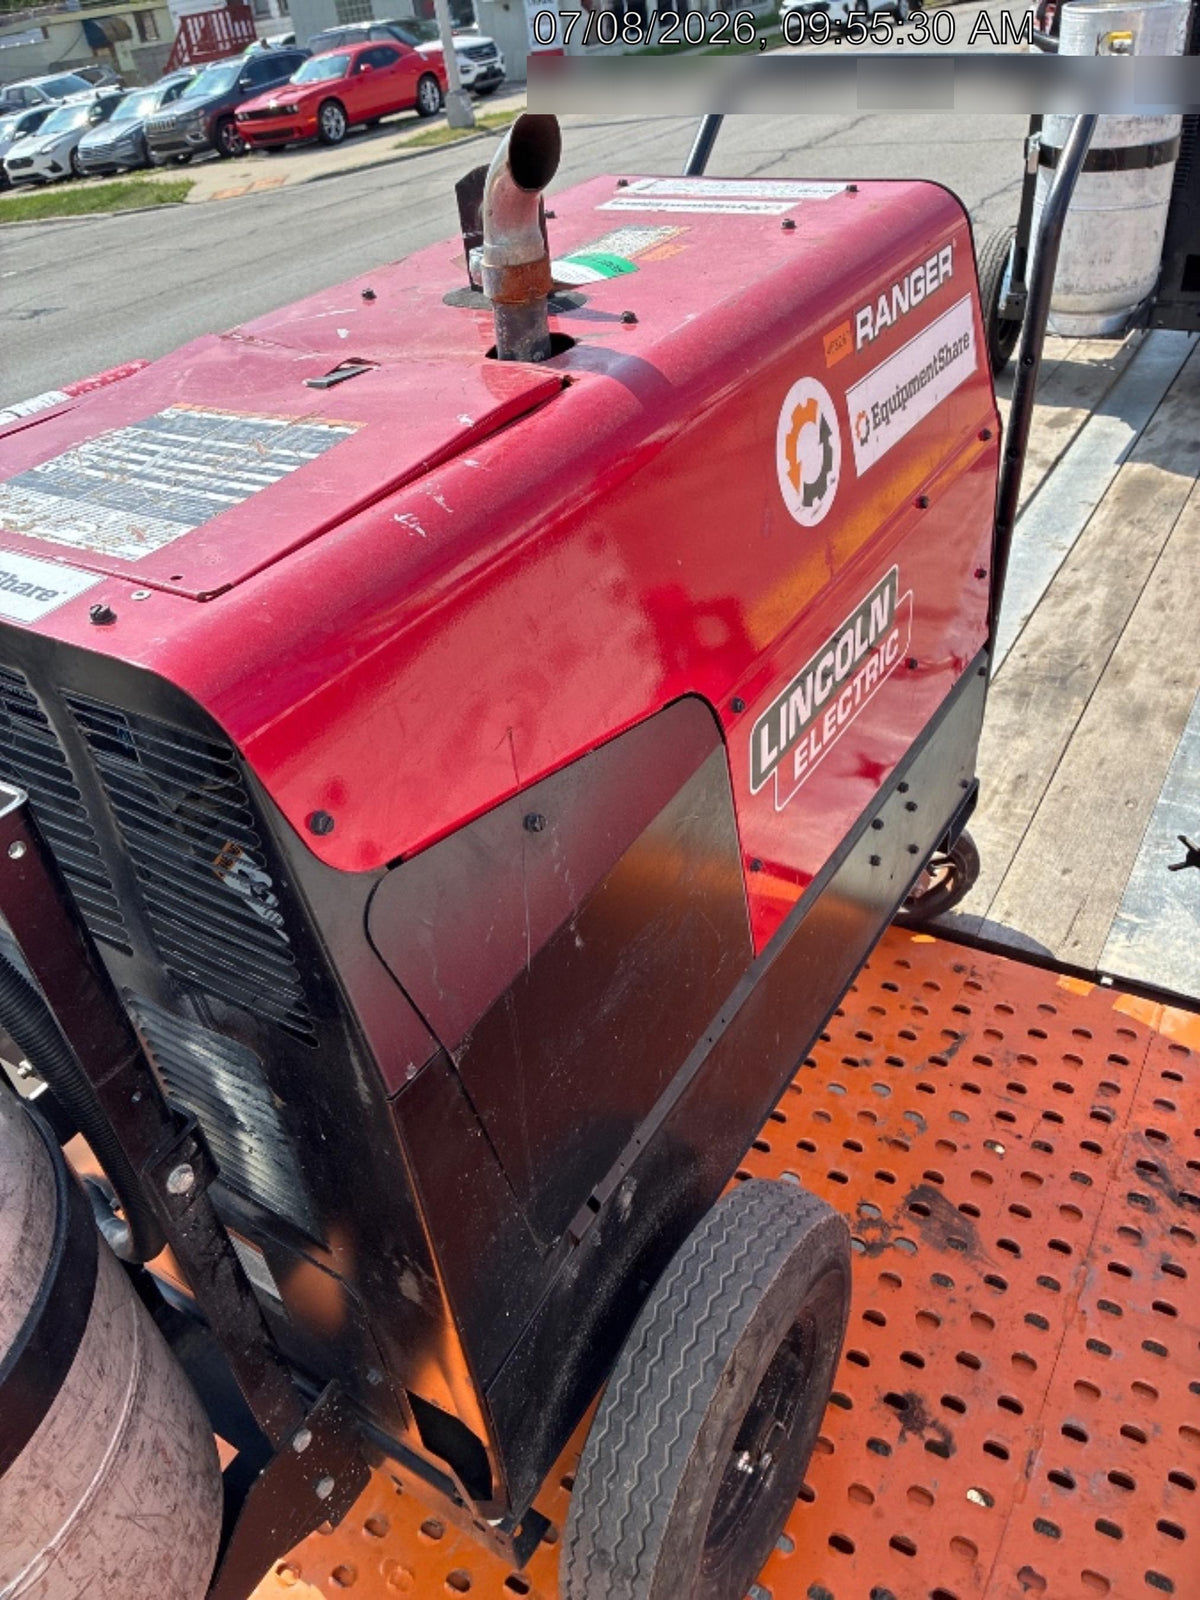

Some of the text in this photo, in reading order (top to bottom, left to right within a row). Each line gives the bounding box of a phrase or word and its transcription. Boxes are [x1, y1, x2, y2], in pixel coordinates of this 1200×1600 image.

[855, 244, 954, 352] RANGER
[870, 331, 970, 431] EquipmentShare
[759, 584, 890, 774] LINCOLN
[794, 628, 900, 780] ELECTRIC
